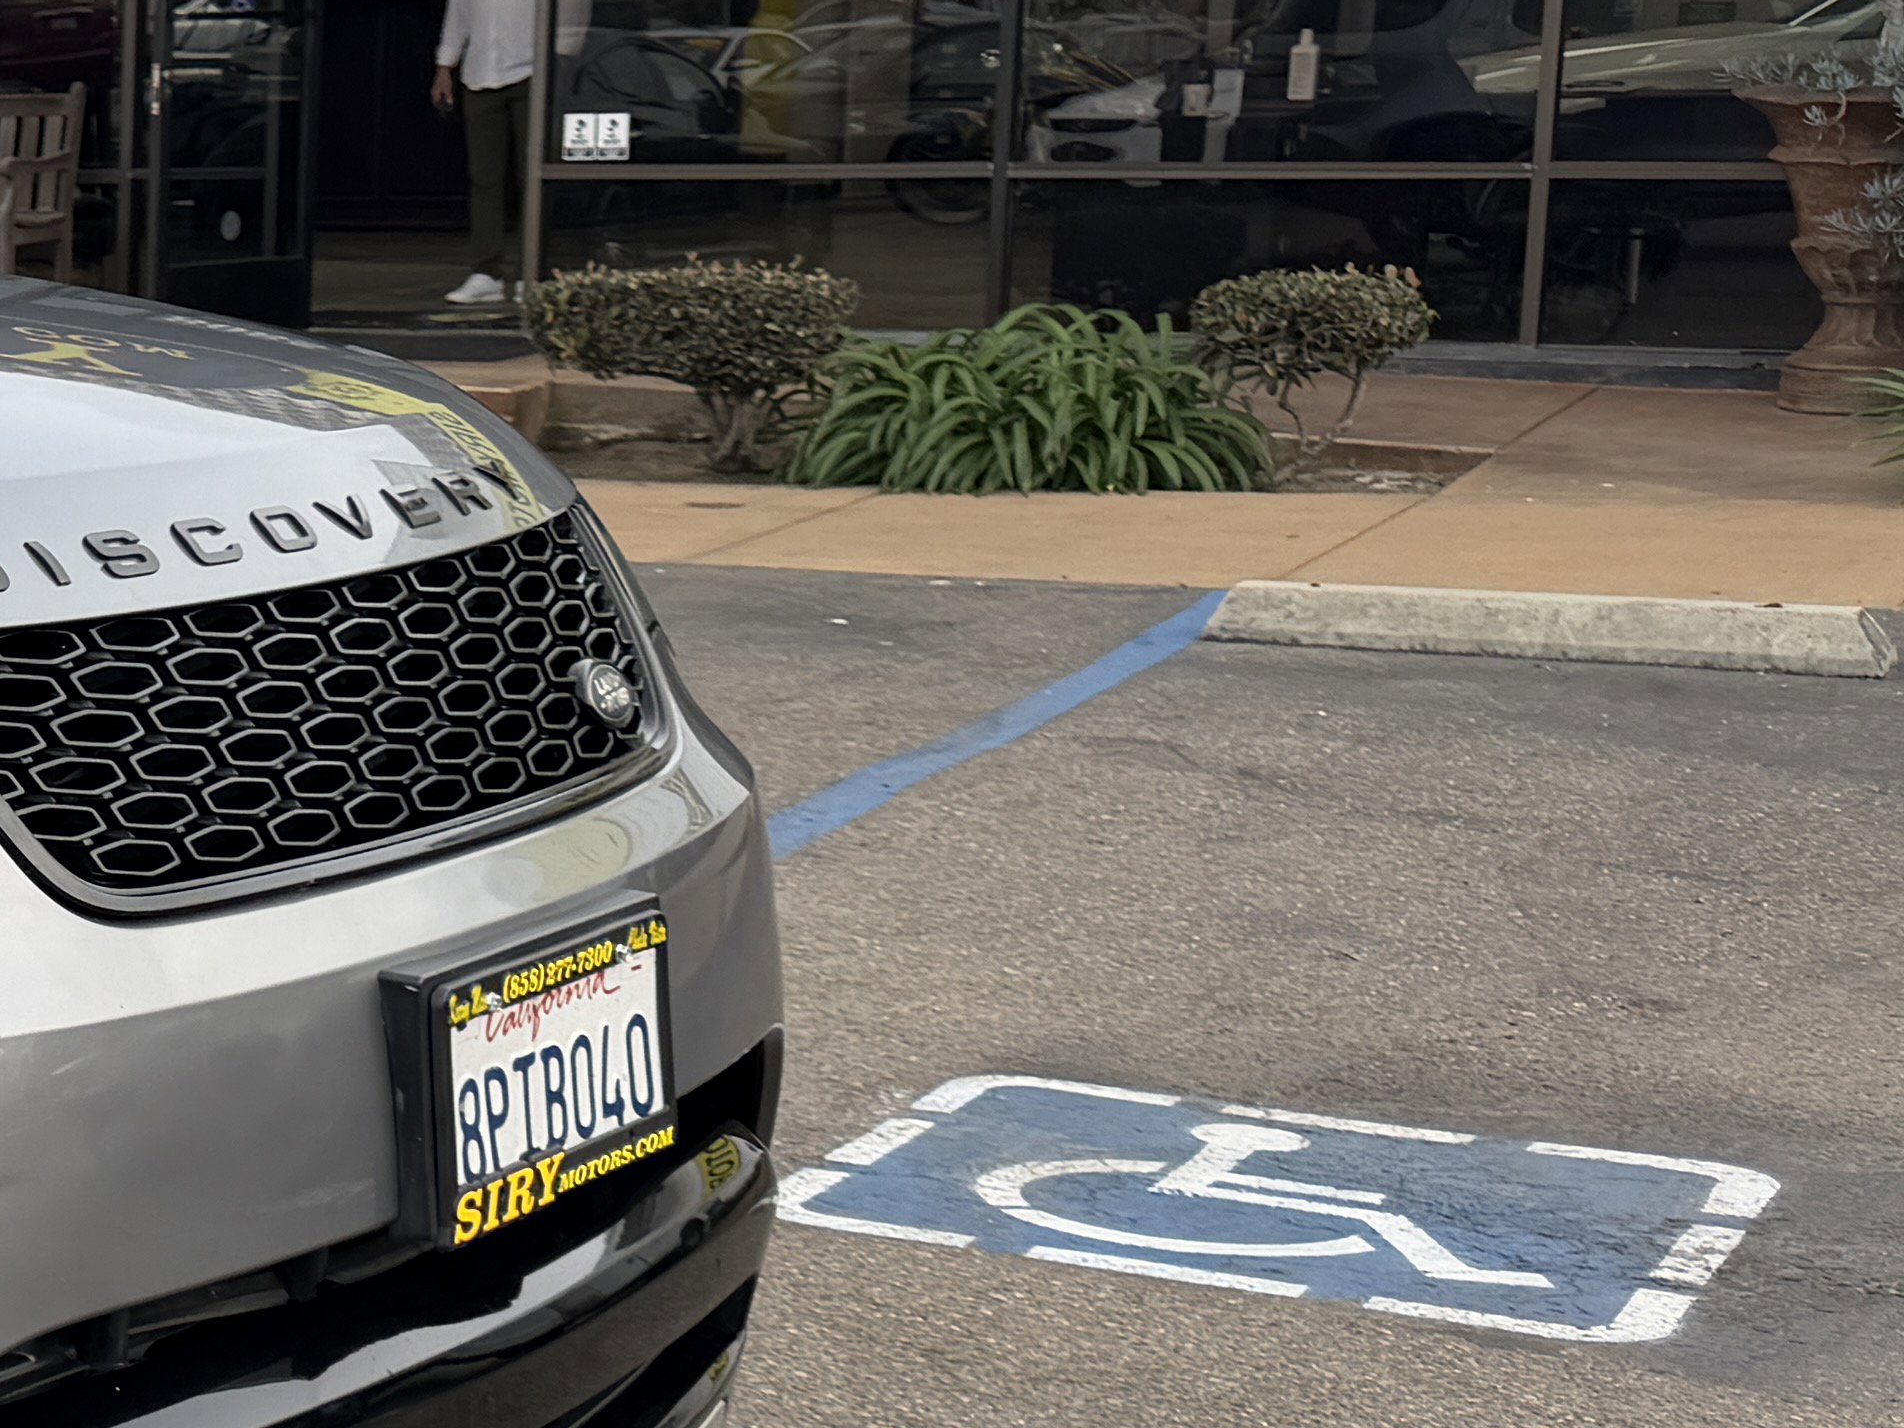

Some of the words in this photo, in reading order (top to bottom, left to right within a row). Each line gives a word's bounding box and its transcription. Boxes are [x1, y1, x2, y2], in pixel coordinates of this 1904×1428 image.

[485, 971, 621, 1043] California
[503, 963, 545, 1004] (858)
[454, 1152, 565, 1245] SIRY
[558, 1126, 675, 1194] MOTORS.COM
